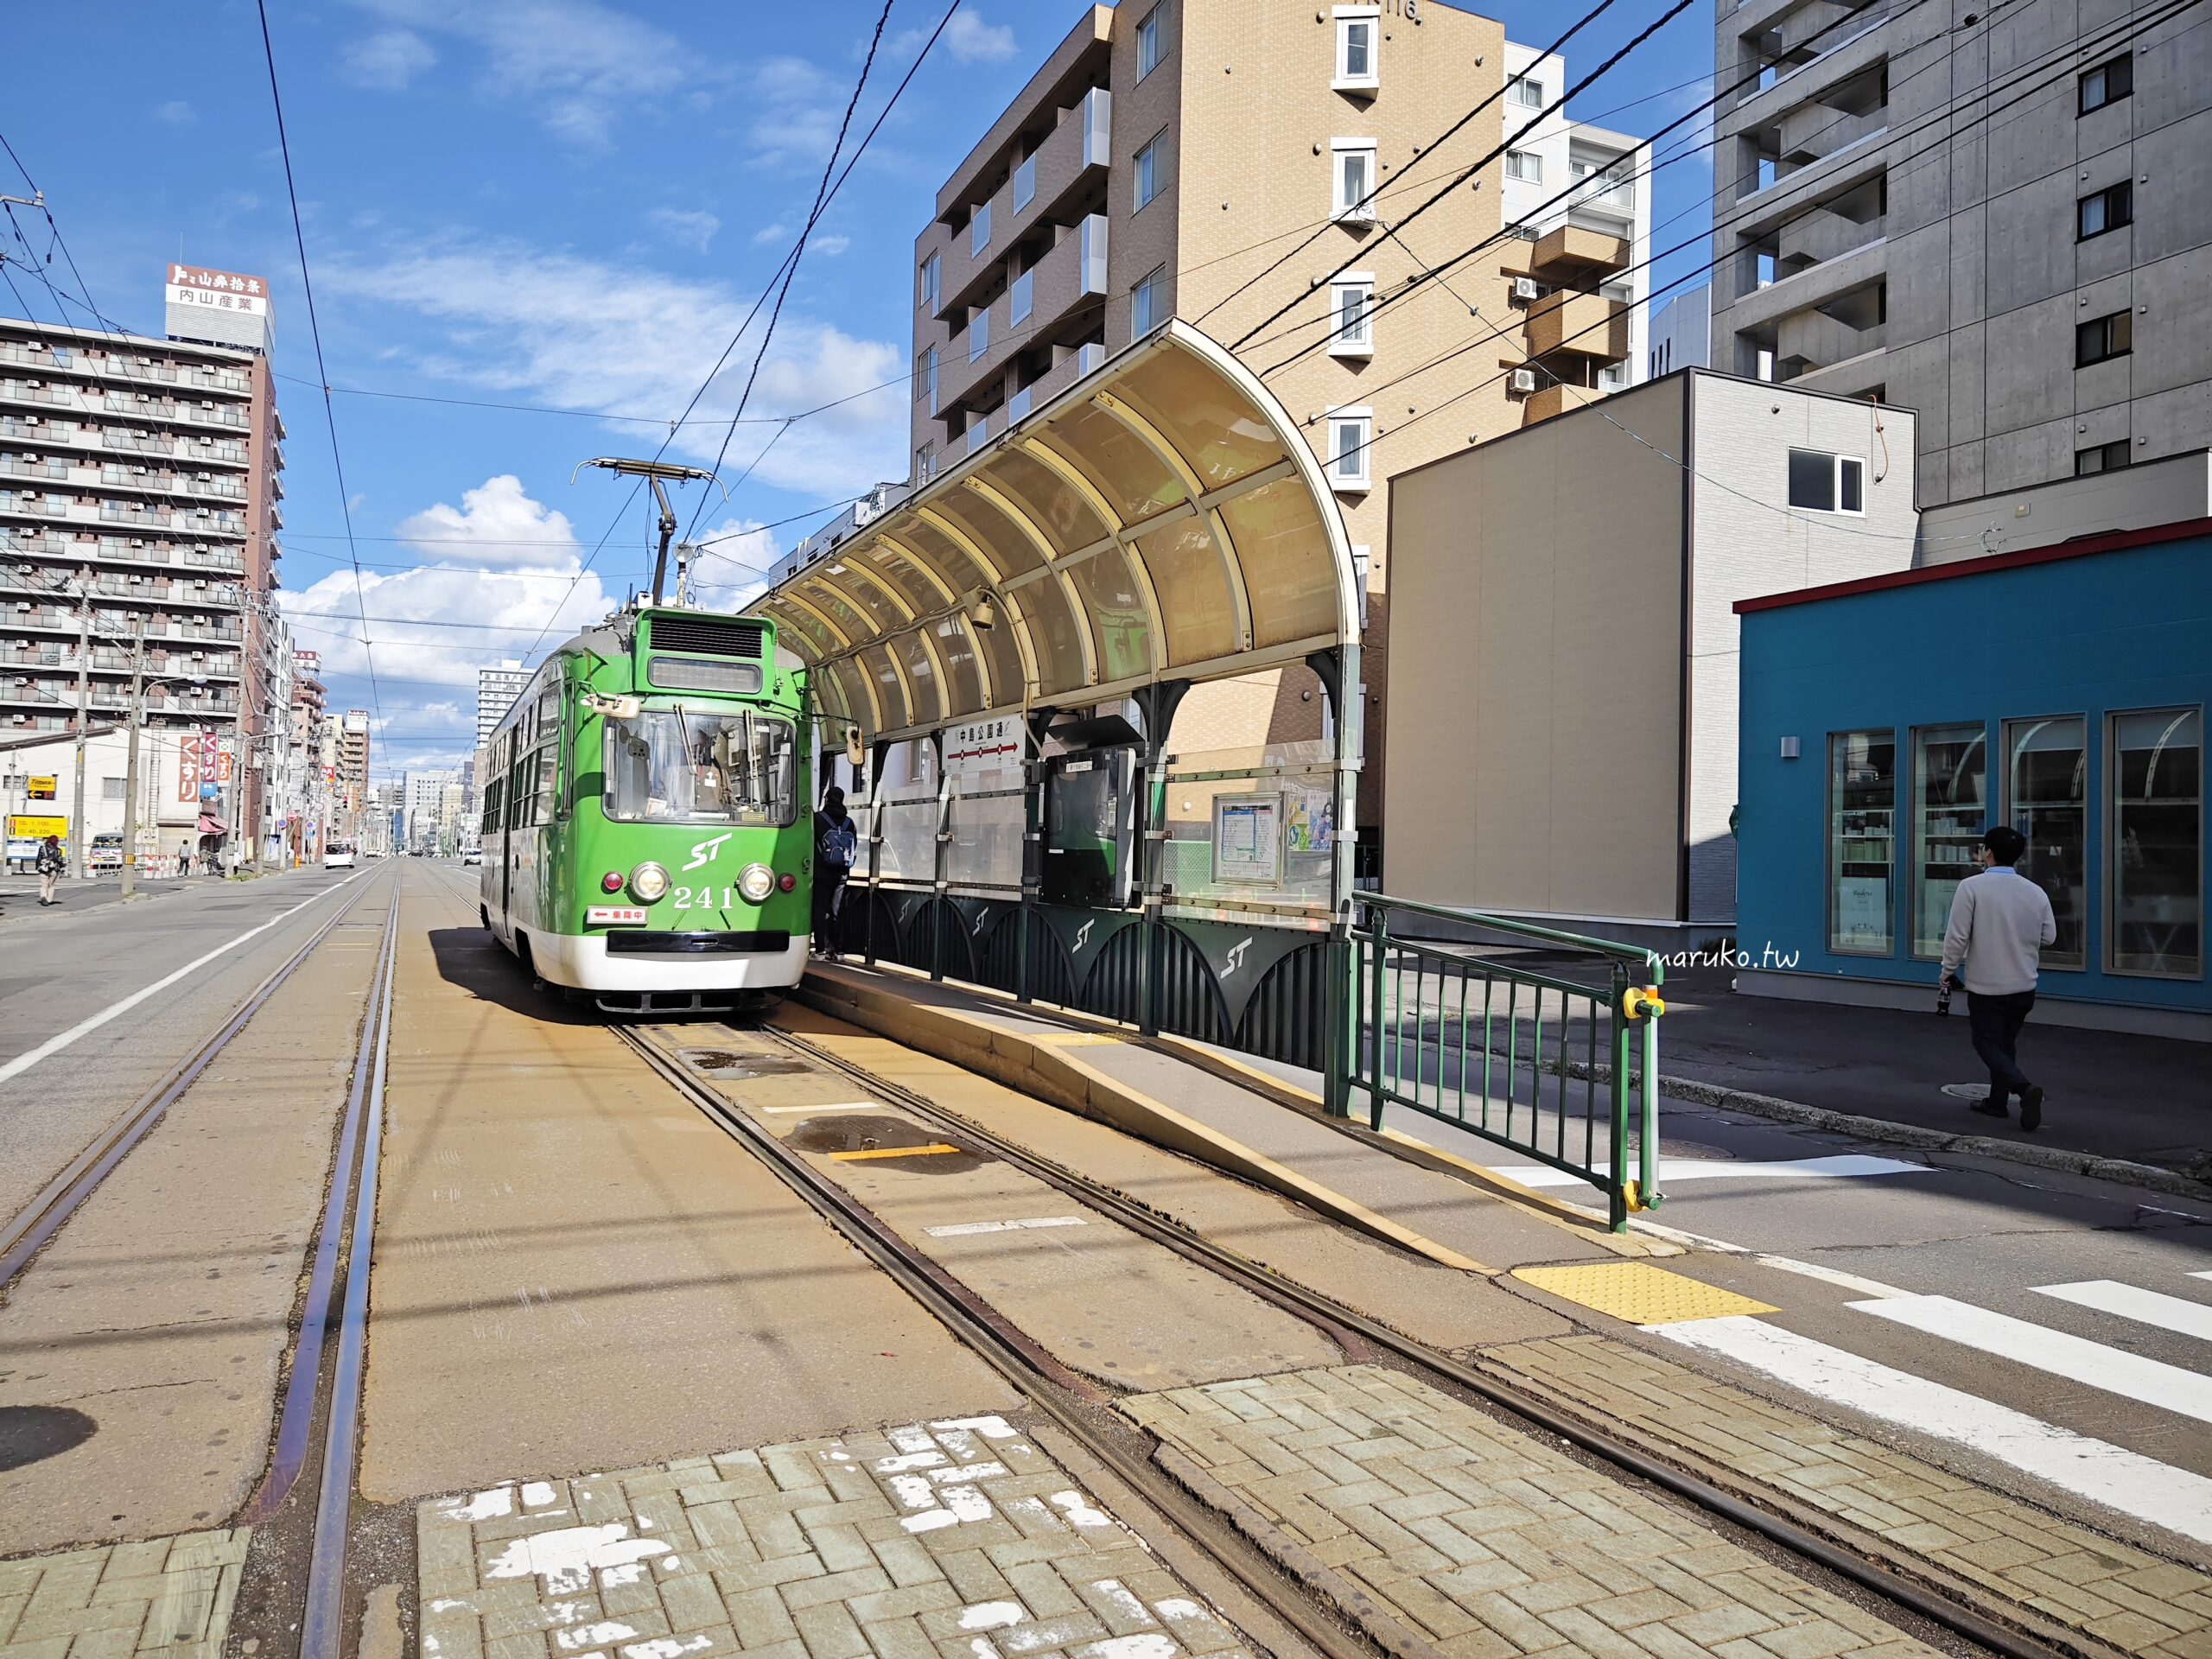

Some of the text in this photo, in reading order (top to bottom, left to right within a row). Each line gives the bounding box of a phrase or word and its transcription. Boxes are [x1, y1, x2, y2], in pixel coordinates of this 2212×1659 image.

[180, 289, 251, 310] 内山産業
[181, 740, 198, 800] くすり
[205, 736, 216, 779] くすり
[219, 755, 229, 779] くすり
[682, 832, 732, 872] ST
[674, 887, 733, 909] 241
[973, 906, 988, 937] ST
[1072, 918, 1095, 954] ST
[1220, 937, 1253, 979] ST
